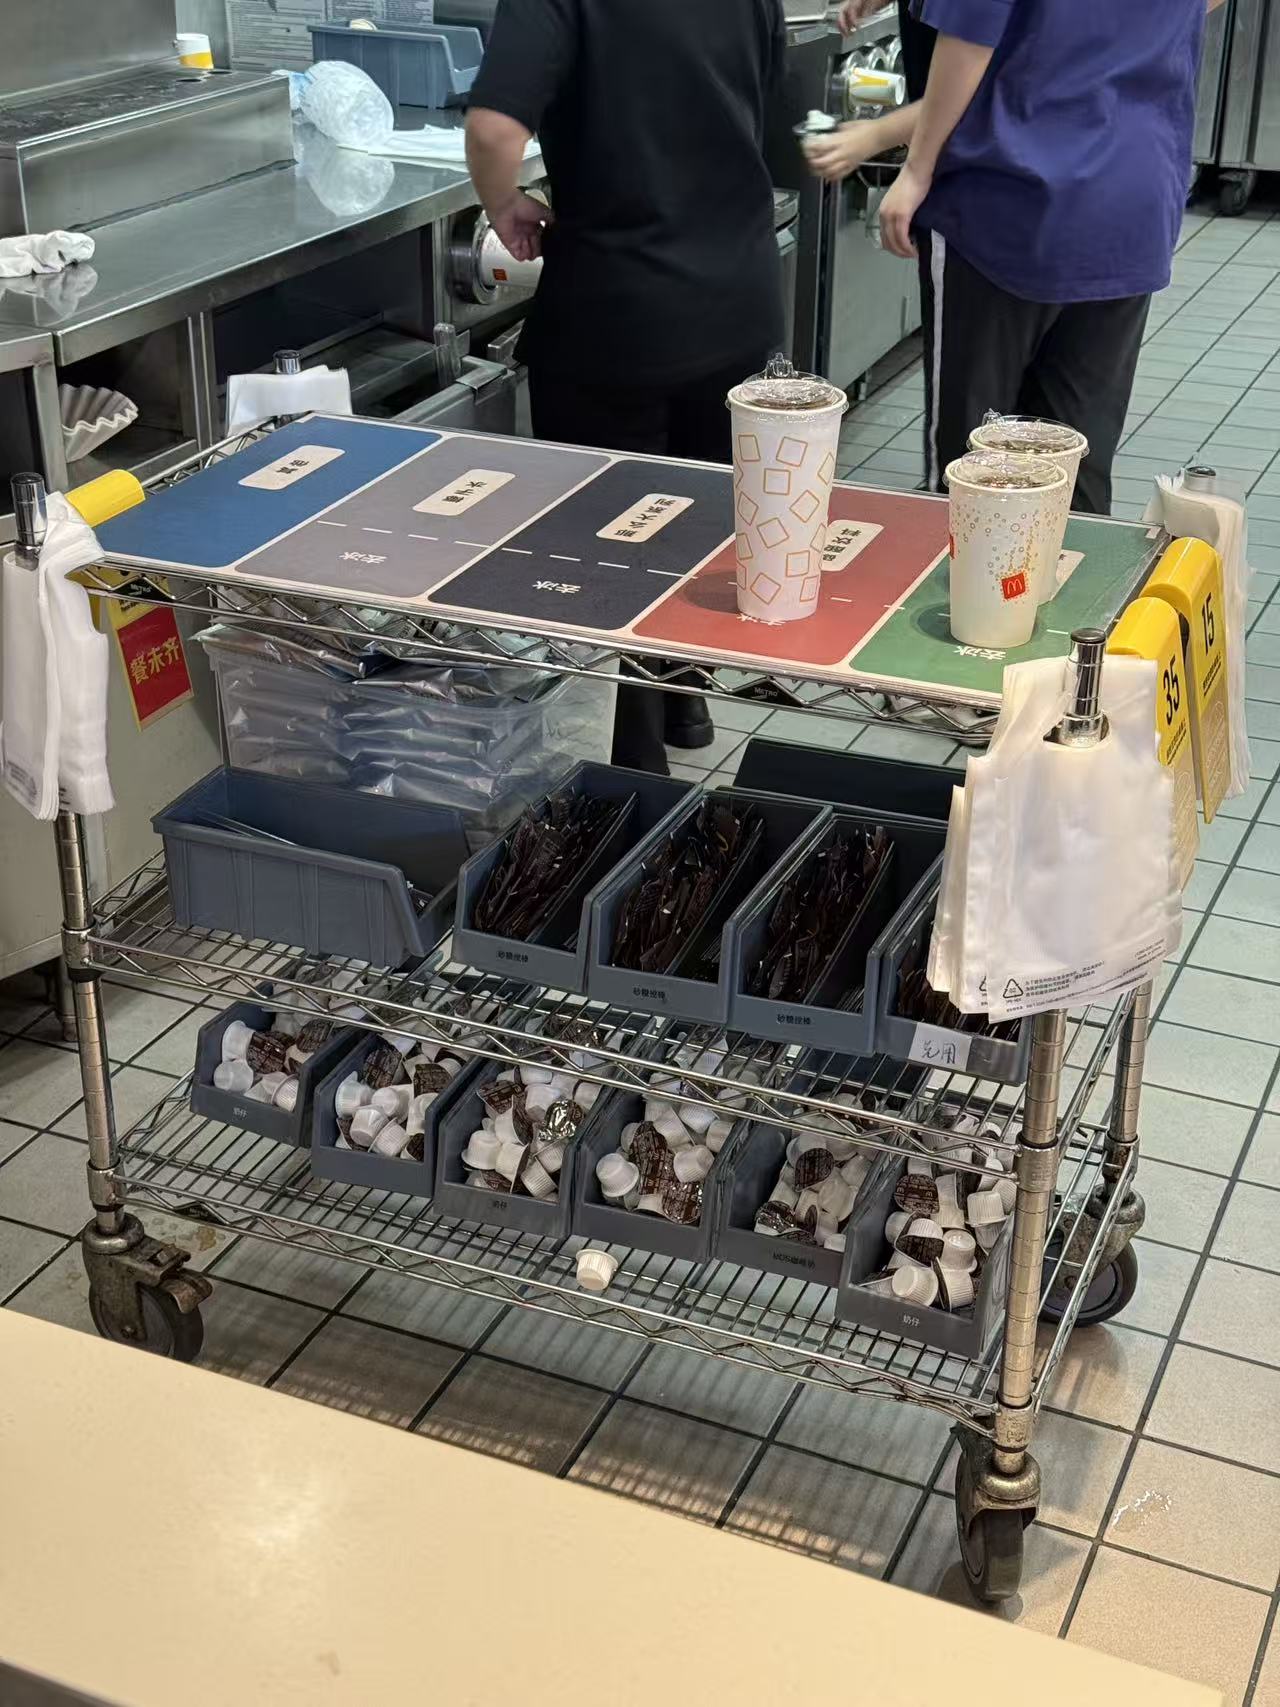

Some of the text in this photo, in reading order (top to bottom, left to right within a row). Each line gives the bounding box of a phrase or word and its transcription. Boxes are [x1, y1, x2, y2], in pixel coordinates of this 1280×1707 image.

[613, 498, 677, 538] 那么大系列
[339, 550, 389, 565] 去冰
[531, 579, 582, 595] 去冰
[1201, 592, 1216, 656] 15
[129, 636, 180, 686] 餐未齐
[953, 644, 1006, 661] 去冰
[1162, 655, 1180, 726] 35
